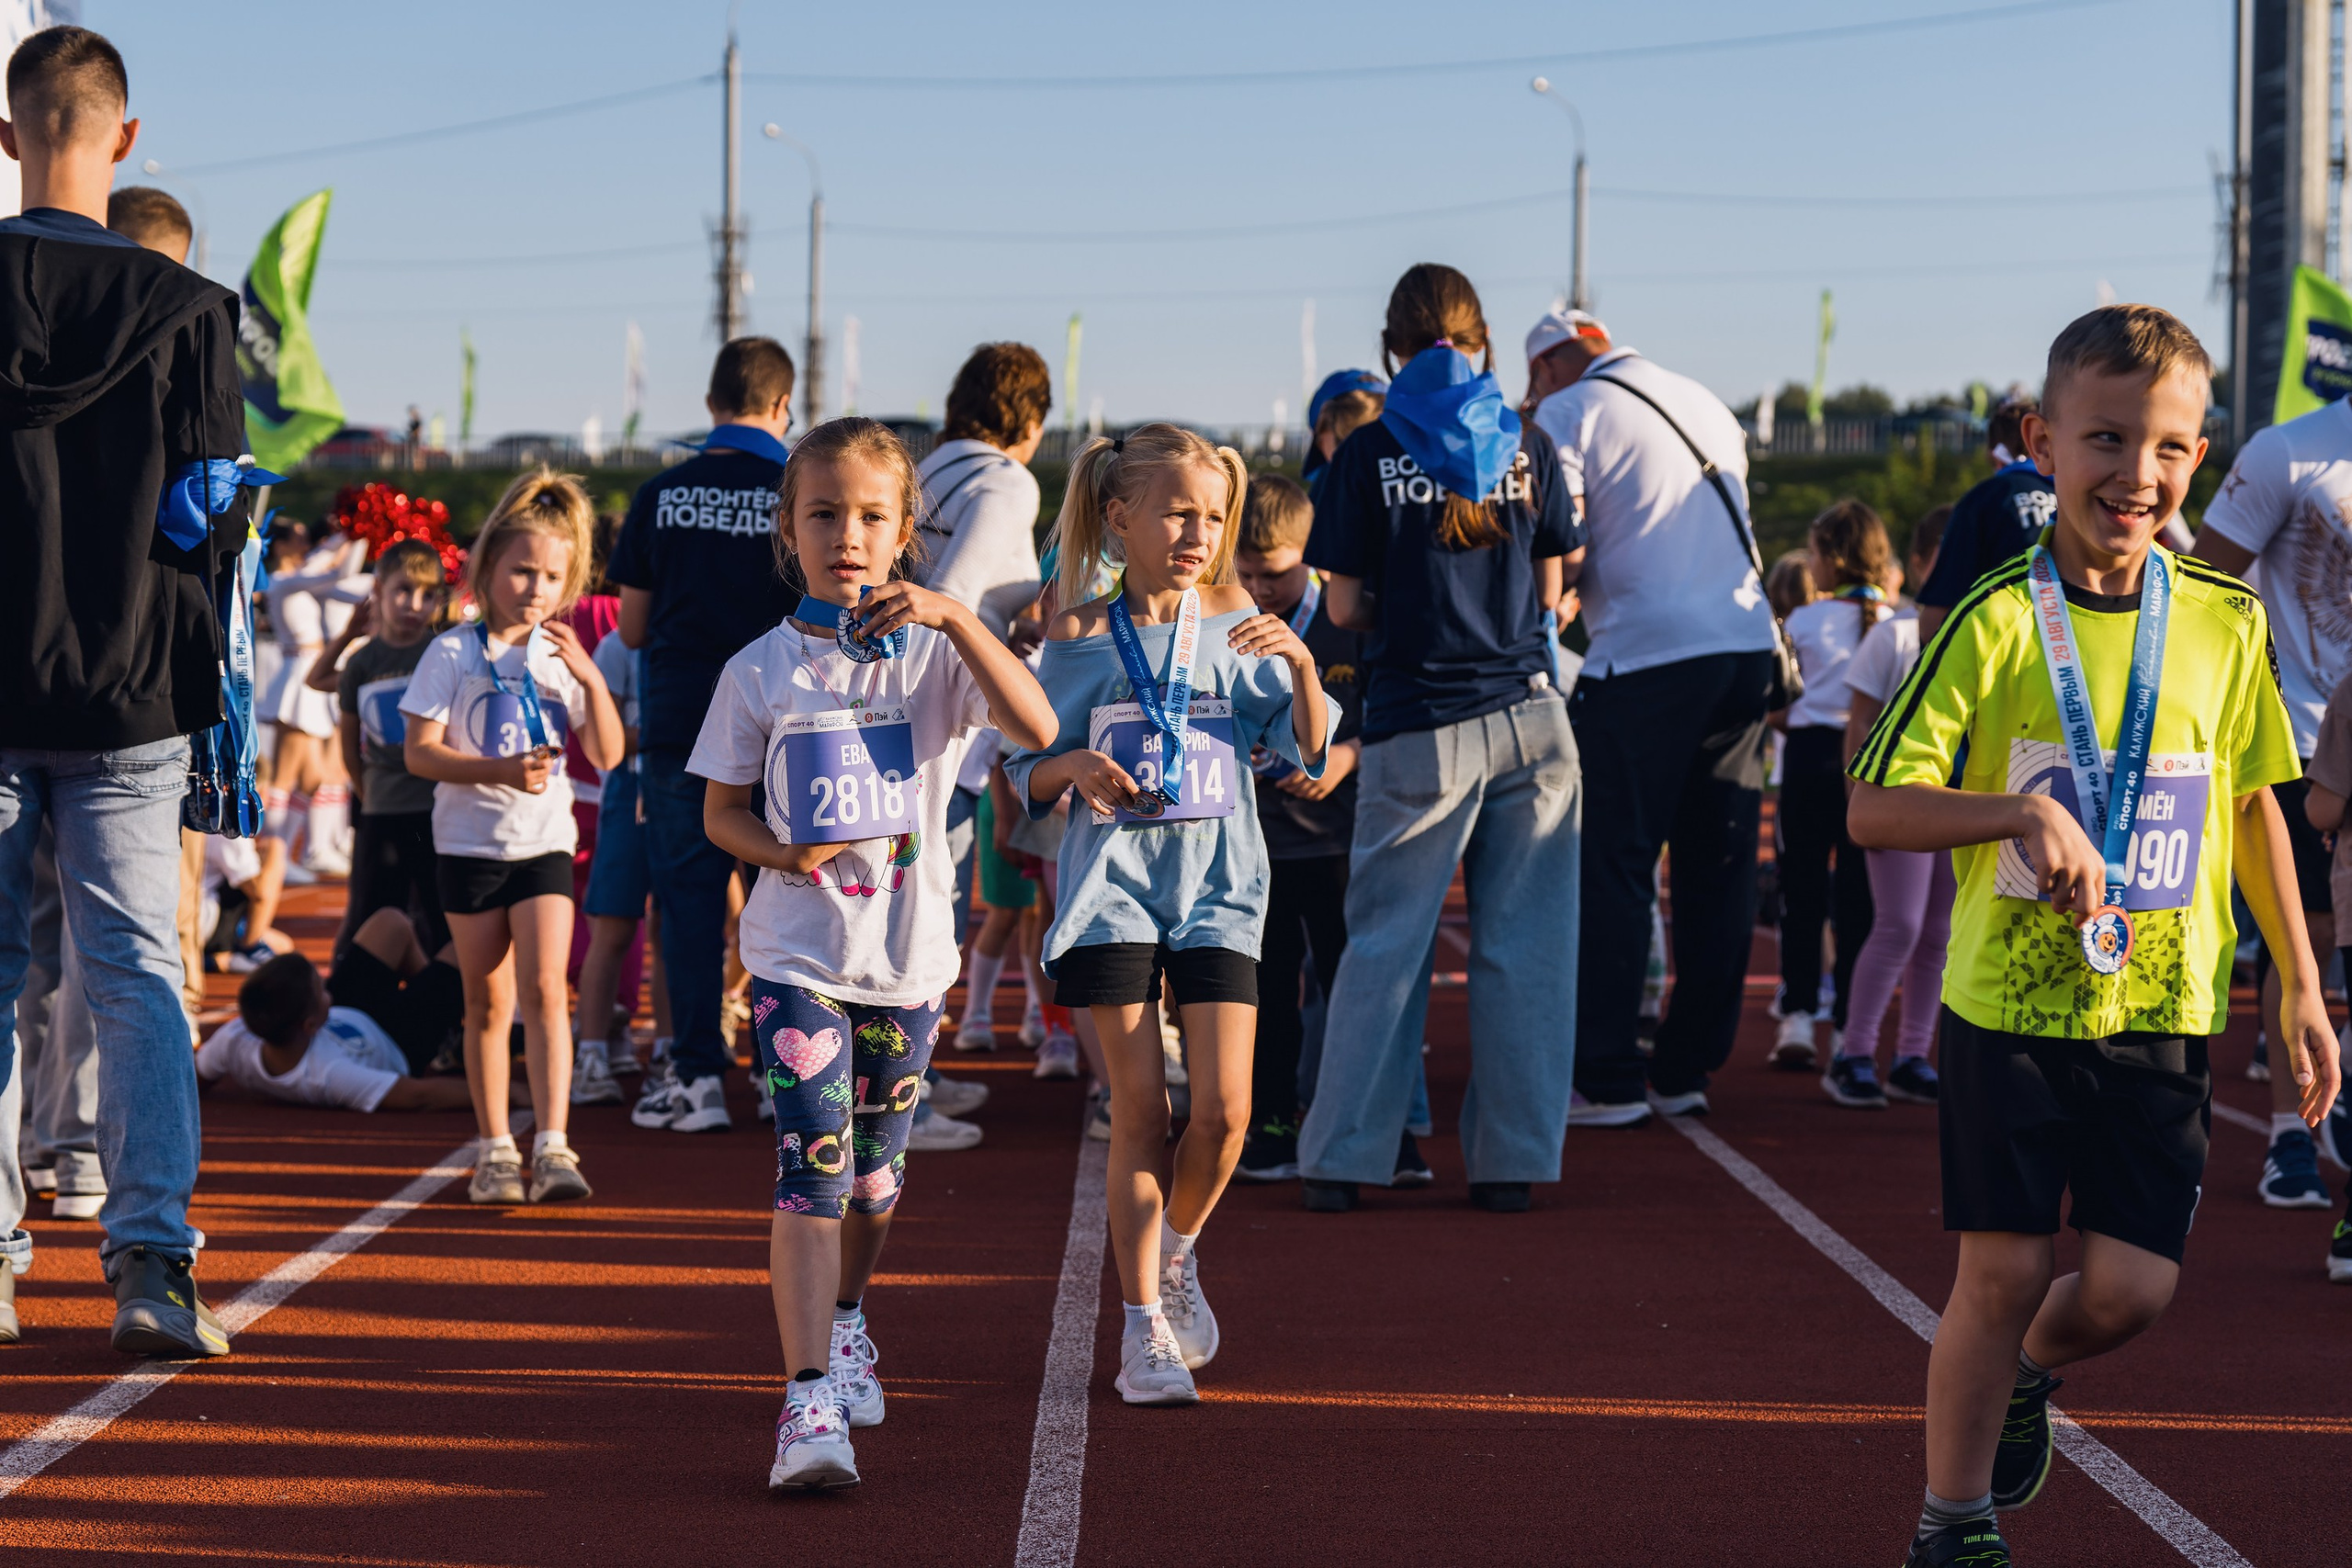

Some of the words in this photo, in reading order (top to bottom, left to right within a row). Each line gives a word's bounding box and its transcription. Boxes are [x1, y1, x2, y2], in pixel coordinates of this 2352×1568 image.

[1185, 592, 1197, 615] 2025
[2149, 561, 2165, 618] МАРАФОН
[1114, 605, 1132, 643] МАРАФОН
[2039, 585, 2066, 643] АВГУСТА
[2224, 597, 2252, 626] adidas
[235, 629, 248, 667] ПЕРВЫМ
[1180, 615, 1196, 652] АВГУСТА
[1178, 652, 1190, 665] 29
[2052, 644, 2071, 661] 29
[236, 669, 250, 697] СТАНЬ
[1172, 666, 1188, 705] ПЕРВЫМ
[2057, 665, 2086, 724] ПЕРВЫМ
[875, 712, 888, 722] Пэй
[1168, 706, 1182, 732] СТАНЬ
[1196, 705, 1210, 715] Пэй
[2128, 688, 2152, 759] КАЛУЖСКИЙ
[841, 743, 871, 766] ЕВА
[1142, 731, 1211, 753] ВАРИЯ
[2071, 725, 2095, 768] СТАНЬ
[2088, 772, 2100, 788] 40
[2127, 770, 2138, 788] 40
[2175, 761, 2190, 770] Пэй
[1135, 758, 1225, 804] 314
[809, 769, 905, 828] 2818
[2119, 788, 2135, 831] СПОРТ
[2135, 790, 2176, 821] МЁН
[1962, 1534, 1982, 1545] TIME
[1982, 1533, 2000, 1541] JUMP
